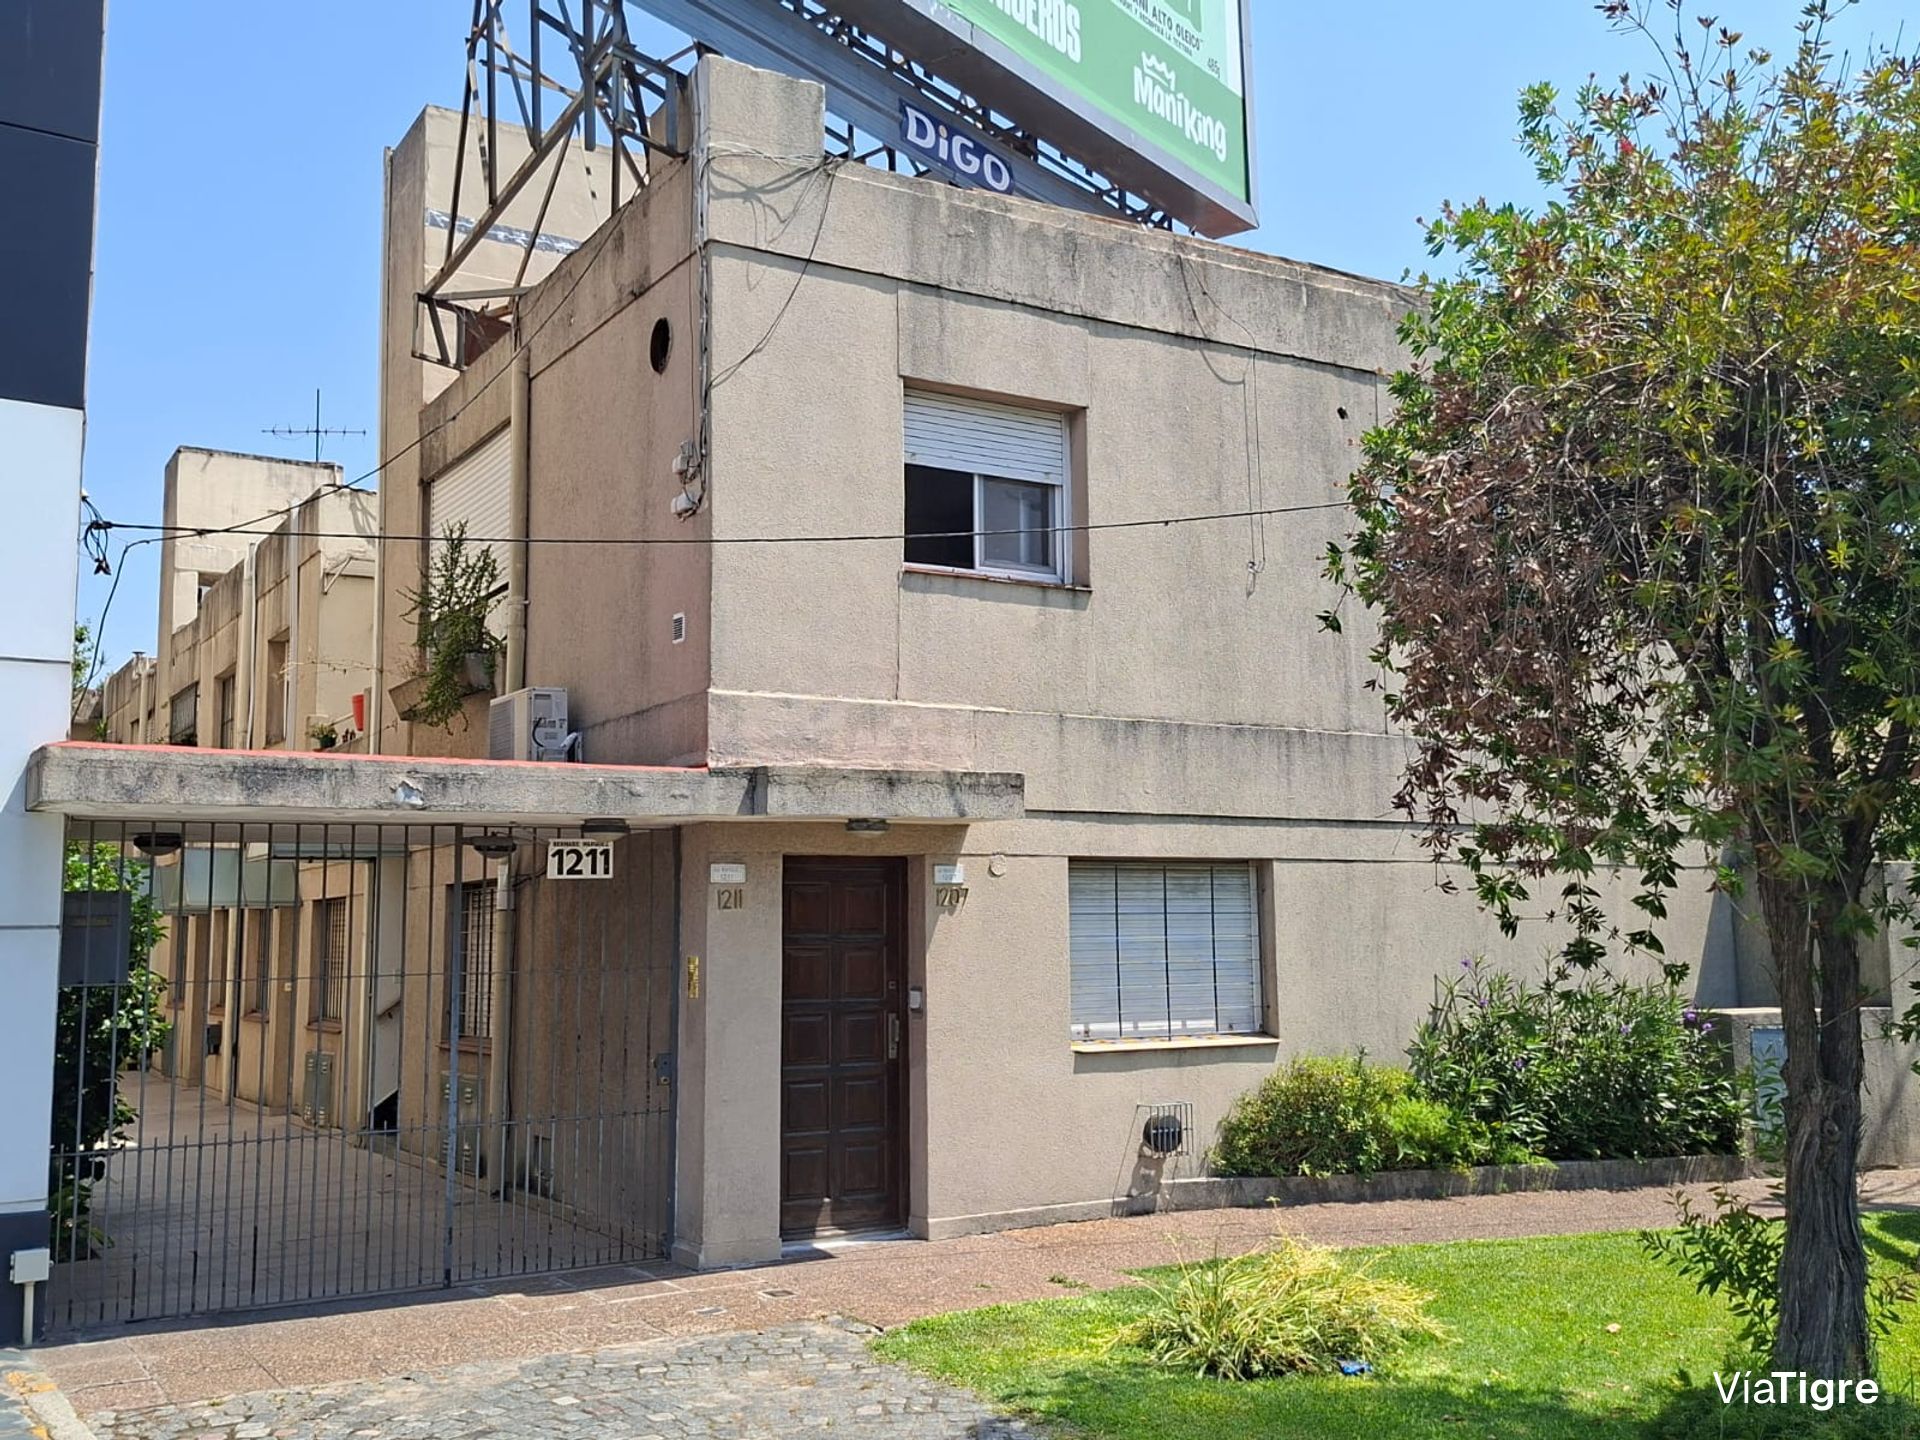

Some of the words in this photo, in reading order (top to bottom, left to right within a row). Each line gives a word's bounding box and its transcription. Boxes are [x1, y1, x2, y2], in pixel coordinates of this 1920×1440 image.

[551, 848, 611, 876] 1211
[717, 889, 743, 910] 1211
[936, 887, 969, 910] 1207
